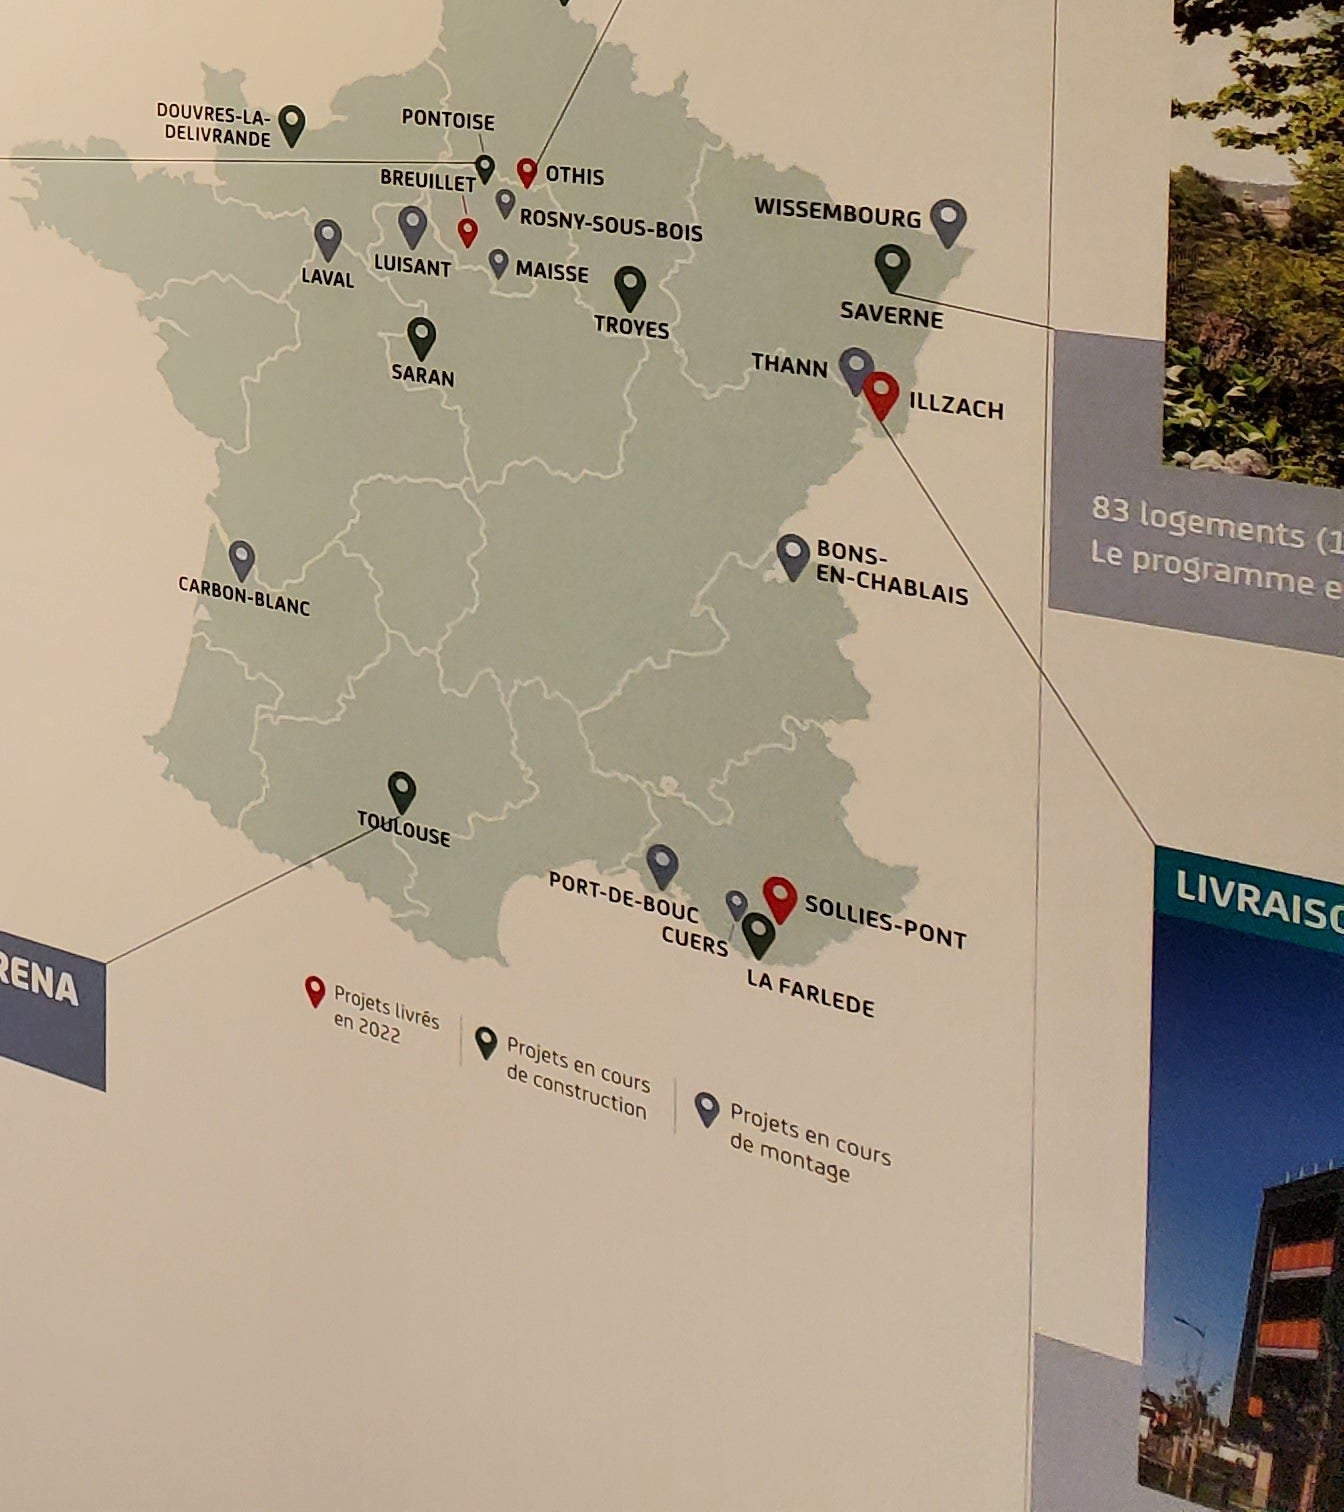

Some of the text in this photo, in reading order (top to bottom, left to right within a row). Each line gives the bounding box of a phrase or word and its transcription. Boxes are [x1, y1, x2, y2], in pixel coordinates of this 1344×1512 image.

[156, 101, 272, 128] DOUVRES-LA-
[401, 108, 496, 132] PONTOISE
[164, 124, 272, 149] DELIVRANDE
[380, 168, 477, 193] BREUILLET
[545, 165, 605, 187] OTHIS
[520, 207, 704, 243] ROSNY-SOUS-BOIS
[754, 196, 922, 229] WISSEMBOURG
[301, 267, 355, 289] LAVAL
[374, 253, 452, 278] LUISANT
[515, 260, 590, 284] MAISSE
[593, 314, 670, 340] TROYES
[840, 301, 945, 329] SAVERNE
[391, 363, 455, 388] SARAN
[751, 352, 829, 379] THANN
[910, 391, 1004, 420] ILLZACH
[1092, 494, 1129, 522] 83
[1141, 500, 1305, 549] logements
[817, 539, 888, 565] BONS-
[1091, 538, 1314, 596] Le programme
[179, 576, 311, 617] CARBON-BLANC
[816, 564, 969, 606] EN-CHABLAIS
[357, 810, 450, 848] TOULOUSE
[549, 870, 700, 925] PORT-DE-BOUC
[805, 894, 968, 951] SOLLIES-PONT
[661, 926, 730, 958] CUERS
[334, 984, 441, 1031] Projets livrés
[747, 969, 876, 1019] LA FARLEDE
[334, 1012, 401, 1045] en 2022
[507, 1036, 652, 1094] Projets en cours
[507, 1063, 648, 1121] de construction
[731, 1102, 892, 1167] Projets en cours
[730, 1133, 851, 1184] de montage
